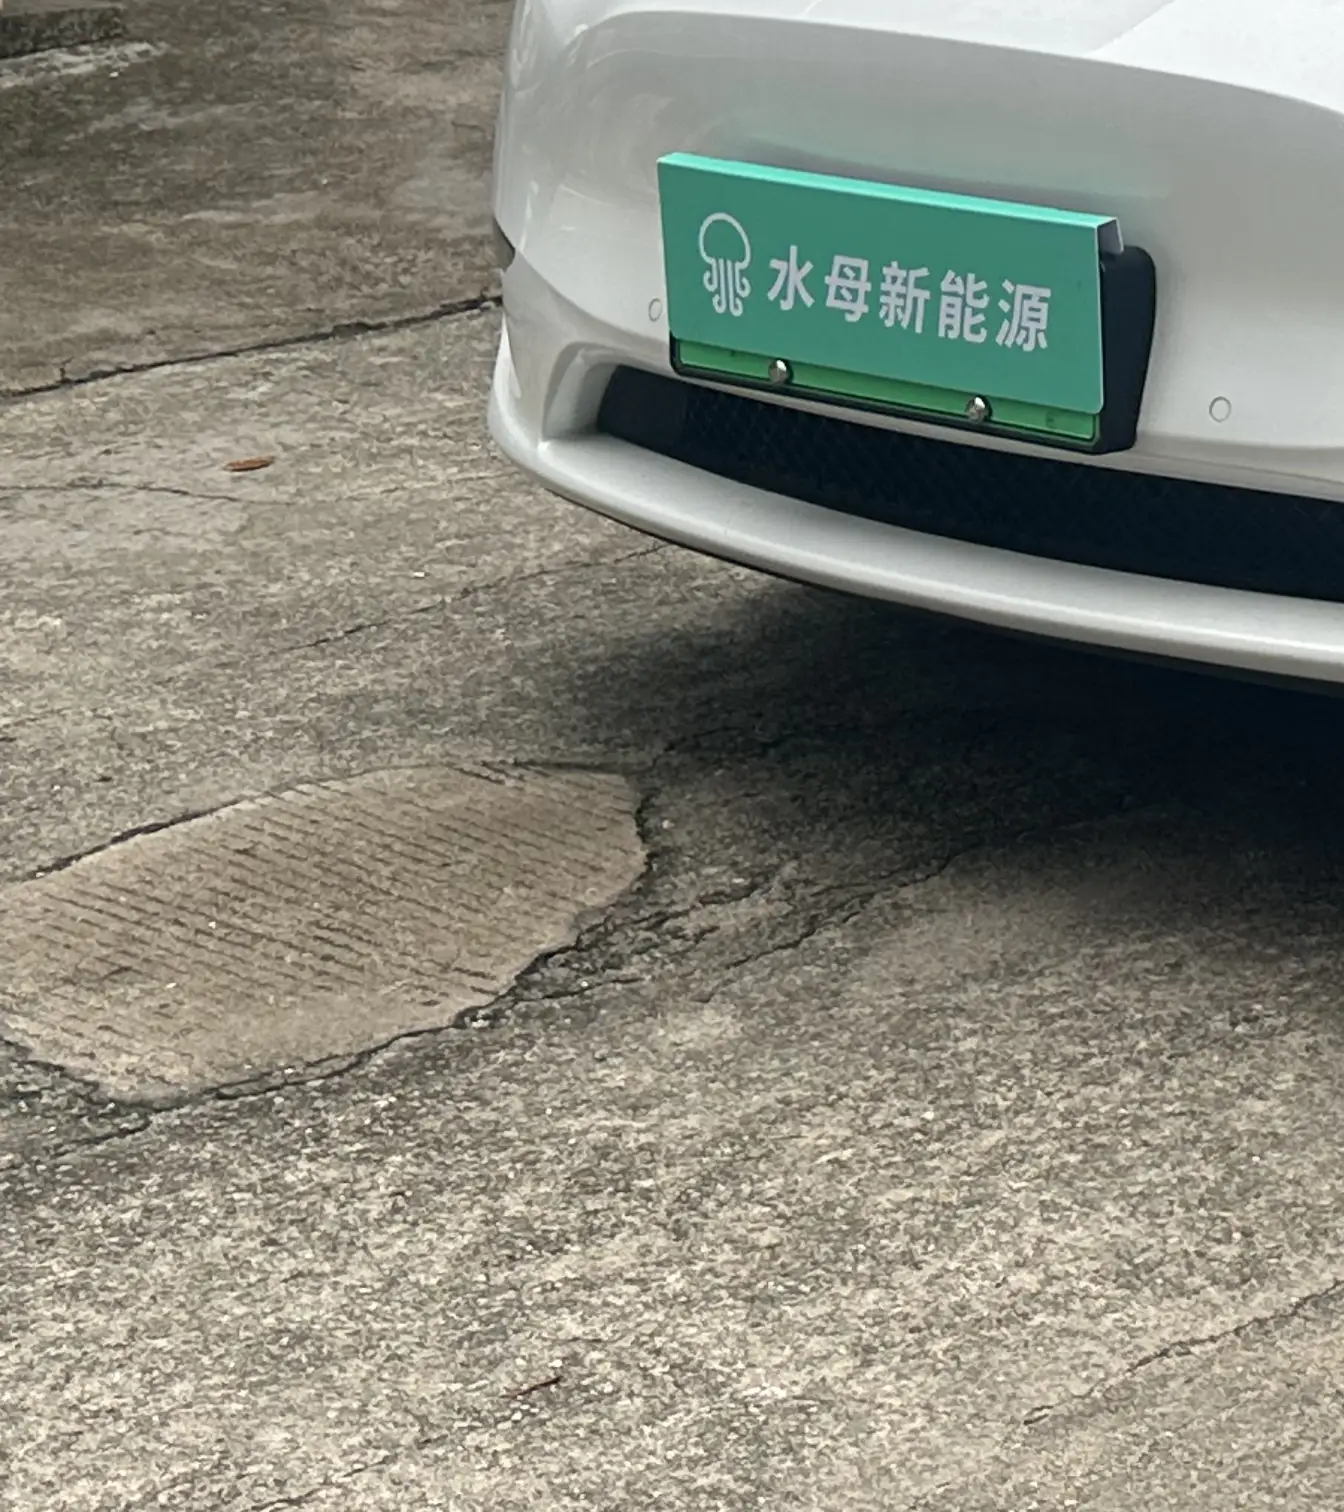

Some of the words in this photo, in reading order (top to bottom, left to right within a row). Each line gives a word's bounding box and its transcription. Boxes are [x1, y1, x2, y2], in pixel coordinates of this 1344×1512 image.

[766, 245, 1052, 353] 水母新能源
